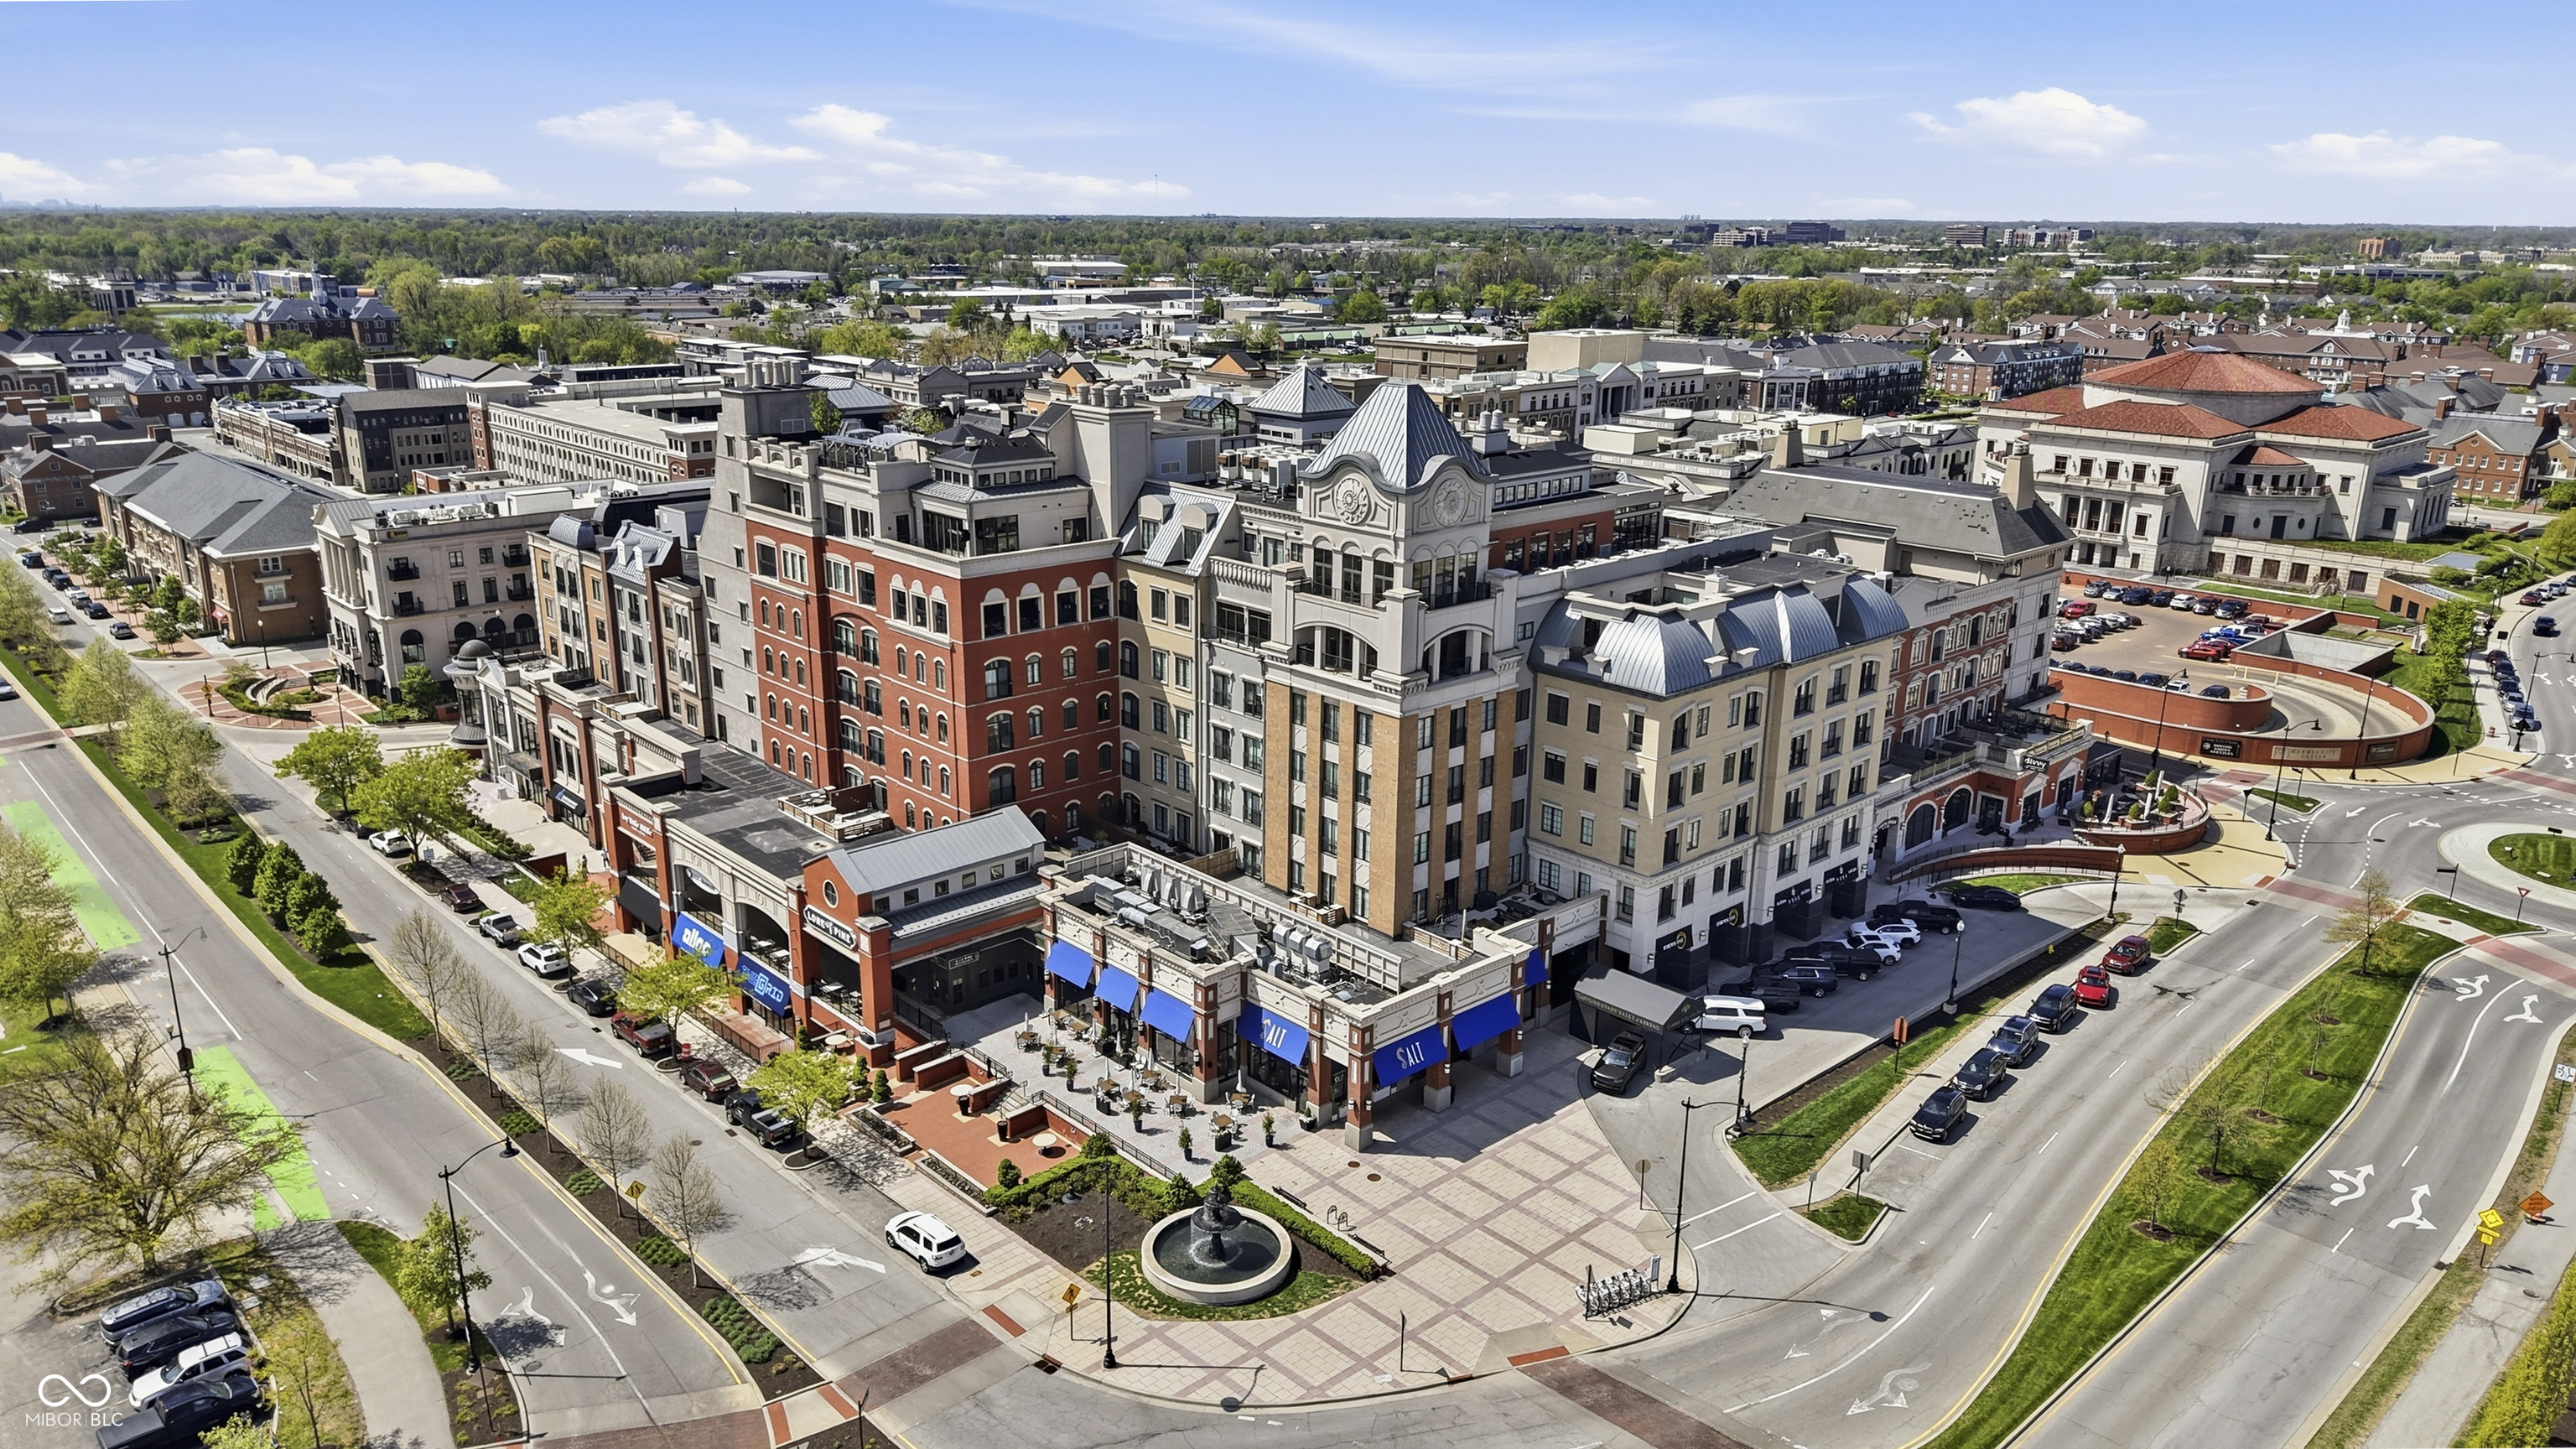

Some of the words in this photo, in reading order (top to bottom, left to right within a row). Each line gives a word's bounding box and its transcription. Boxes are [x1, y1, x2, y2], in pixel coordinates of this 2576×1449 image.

[2023, 757, 2046, 769] divvy
[807, 911, 826, 929] LONE
[833, 926, 852, 944] PINE
[755, 972, 784, 1003] GRID
[1259, 1019, 1287, 1049] SALT
[1395, 1041, 1425, 1070] SALT
